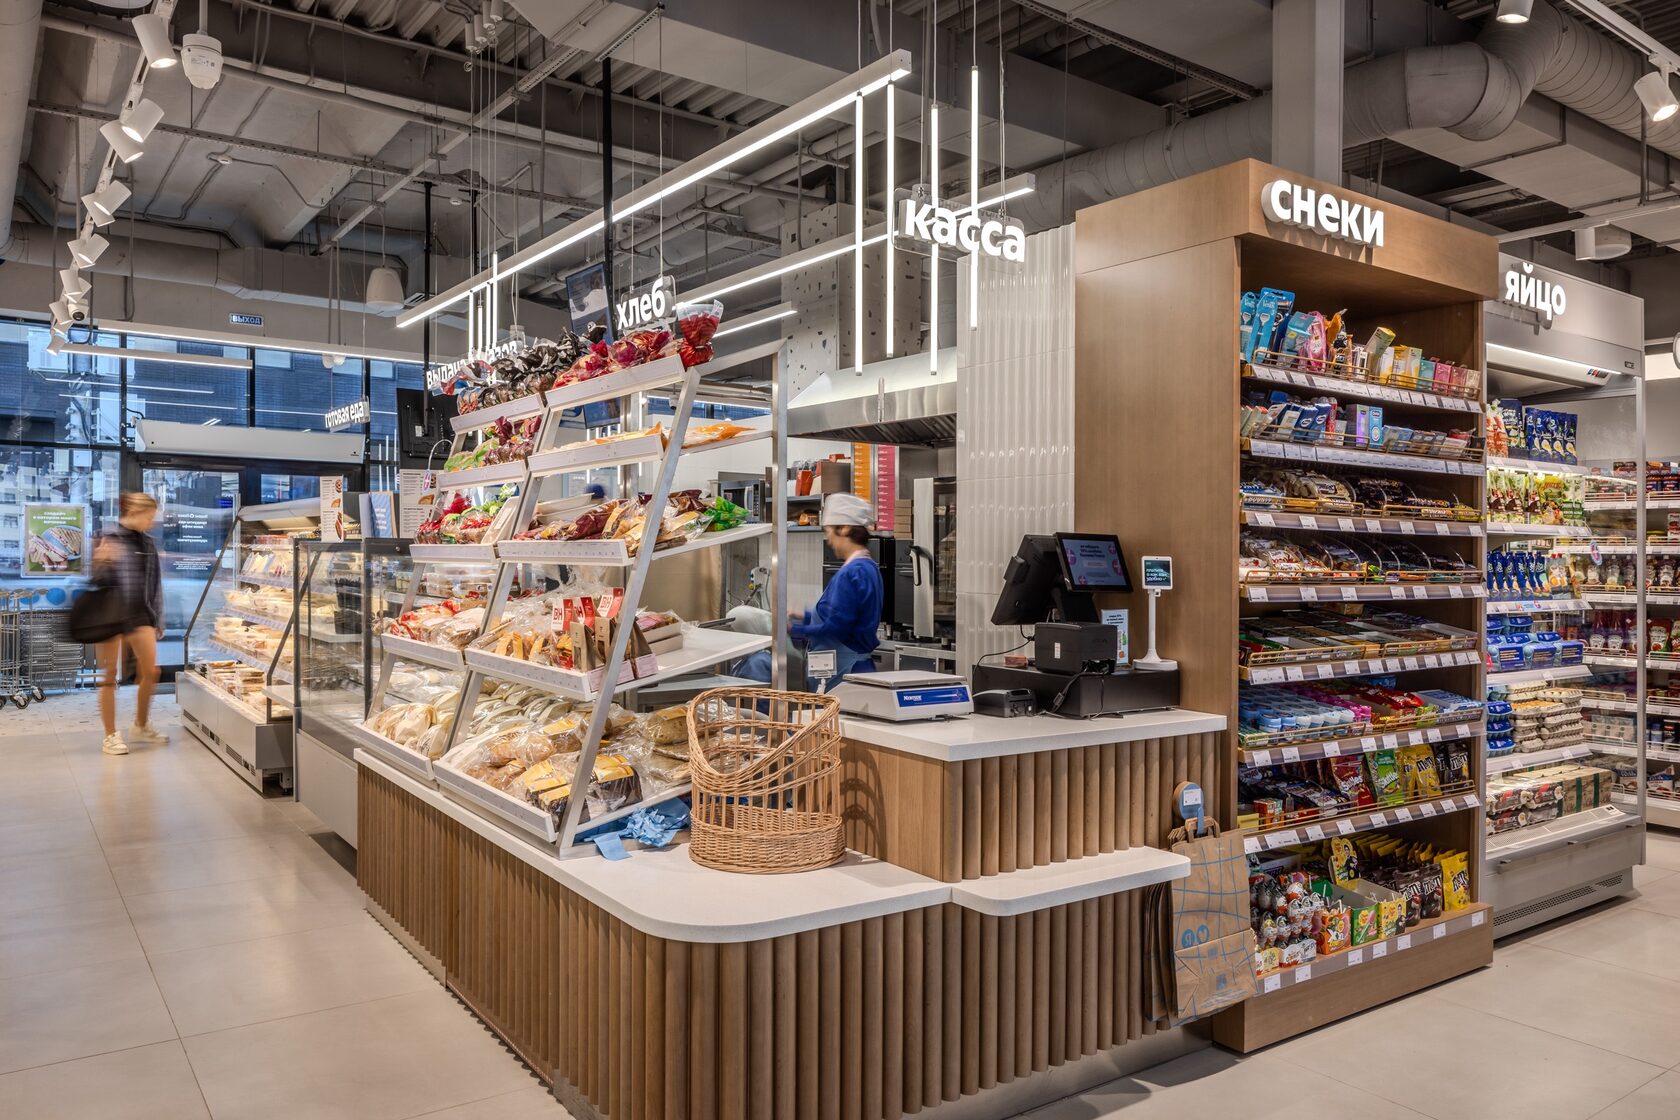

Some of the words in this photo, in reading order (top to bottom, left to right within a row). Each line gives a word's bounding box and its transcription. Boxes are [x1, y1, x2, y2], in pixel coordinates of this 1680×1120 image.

[905, 199, 1025, 262] касса
[1271, 179, 1384, 247] снеки
[232, 314, 261, 325] ВЫХОД
[616, 276, 666, 330] хлеб
[1505, 261, 1567, 321] яйцо
[325, 405, 350, 429] готовая
[350, 401, 364, 424] еда
